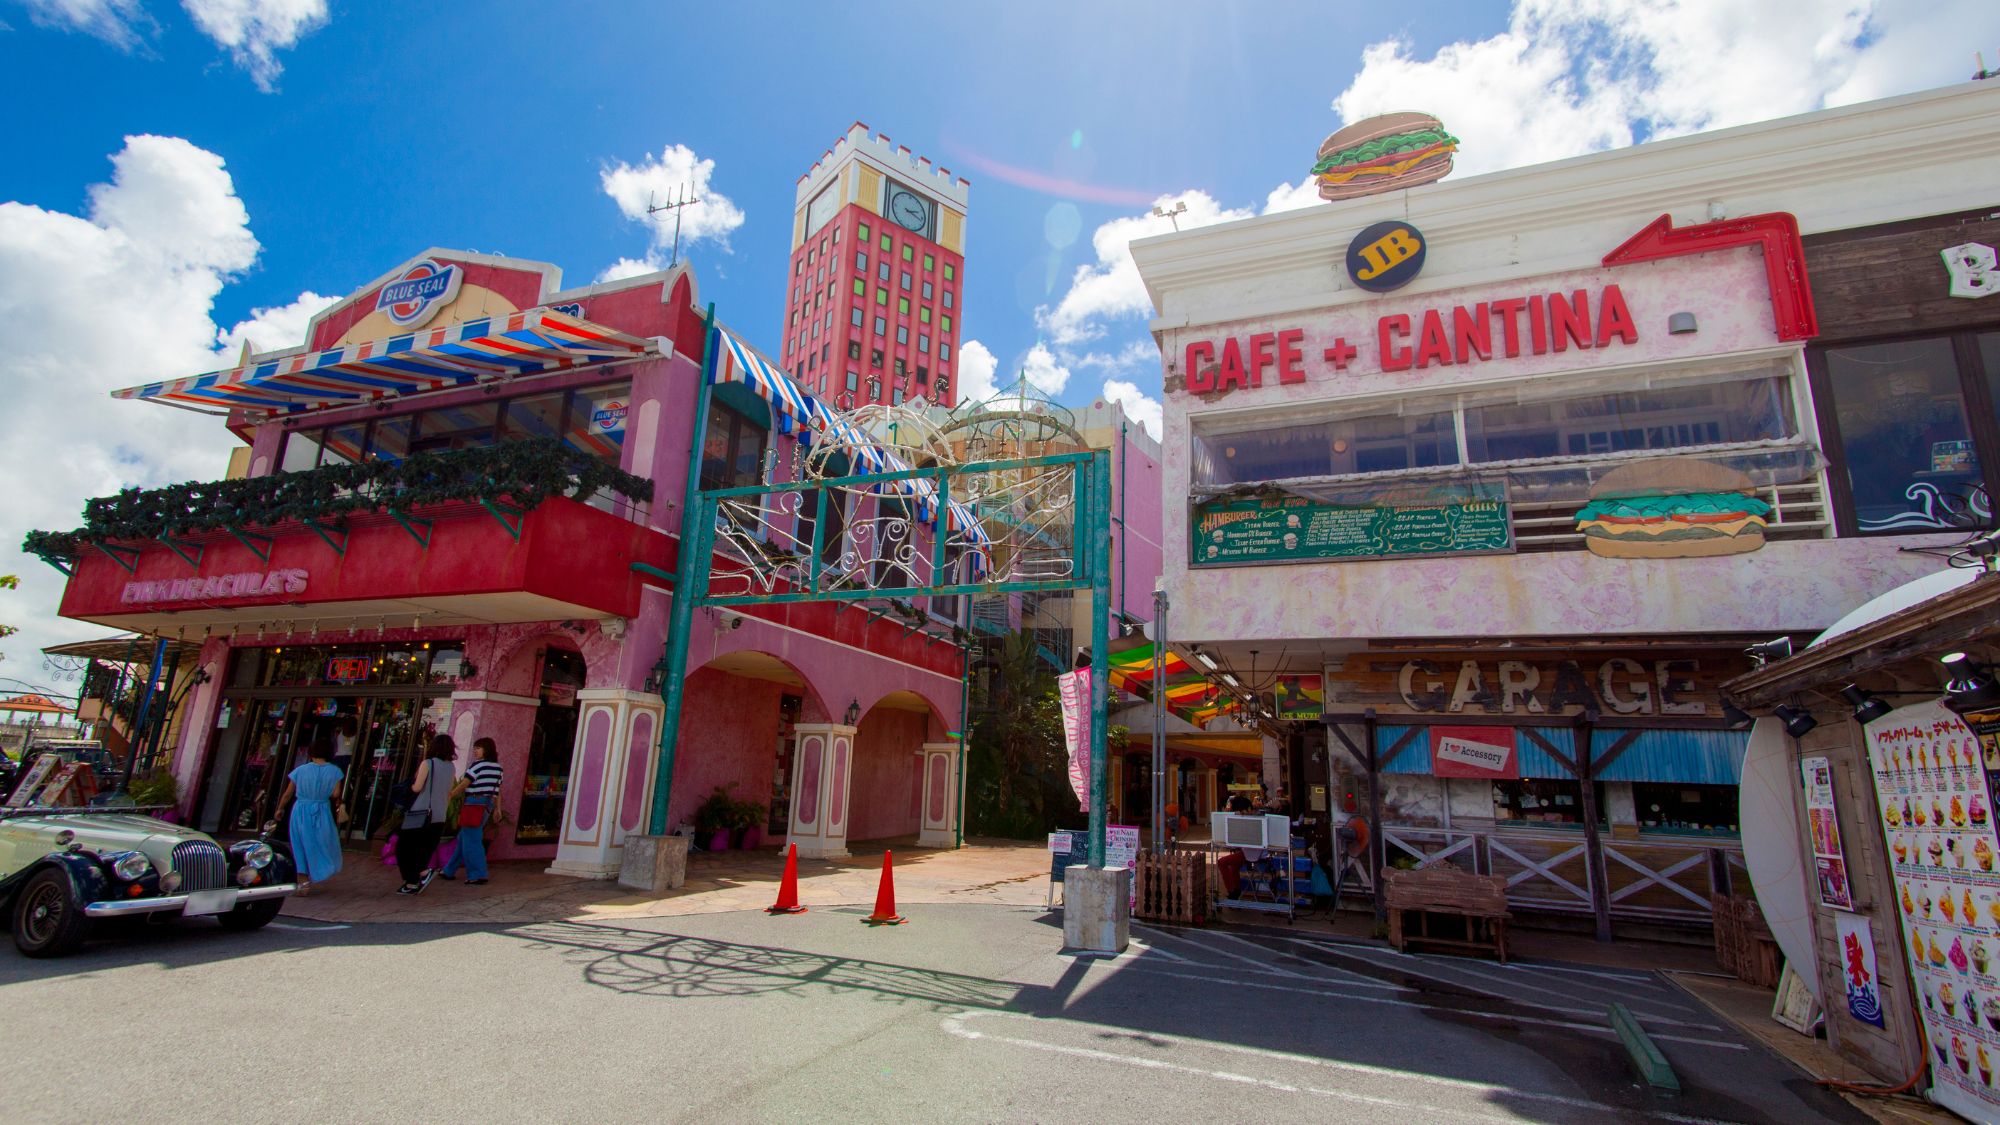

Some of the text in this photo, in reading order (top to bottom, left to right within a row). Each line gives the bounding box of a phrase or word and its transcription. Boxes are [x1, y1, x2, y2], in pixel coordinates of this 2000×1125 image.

[385, 276, 446, 302] BLUE SEAL
[1186, 328, 1306, 395] CAFE
[1378, 284, 1639, 372] CANTINA
[596, 410, 611, 420] BLUE
[1200, 510, 1258, 533] HAMBURGER
[328, 658, 369, 681] OPEN
[1399, 659, 1706, 715] GARAGE
[1461, 746, 1502, 764] Accessory
